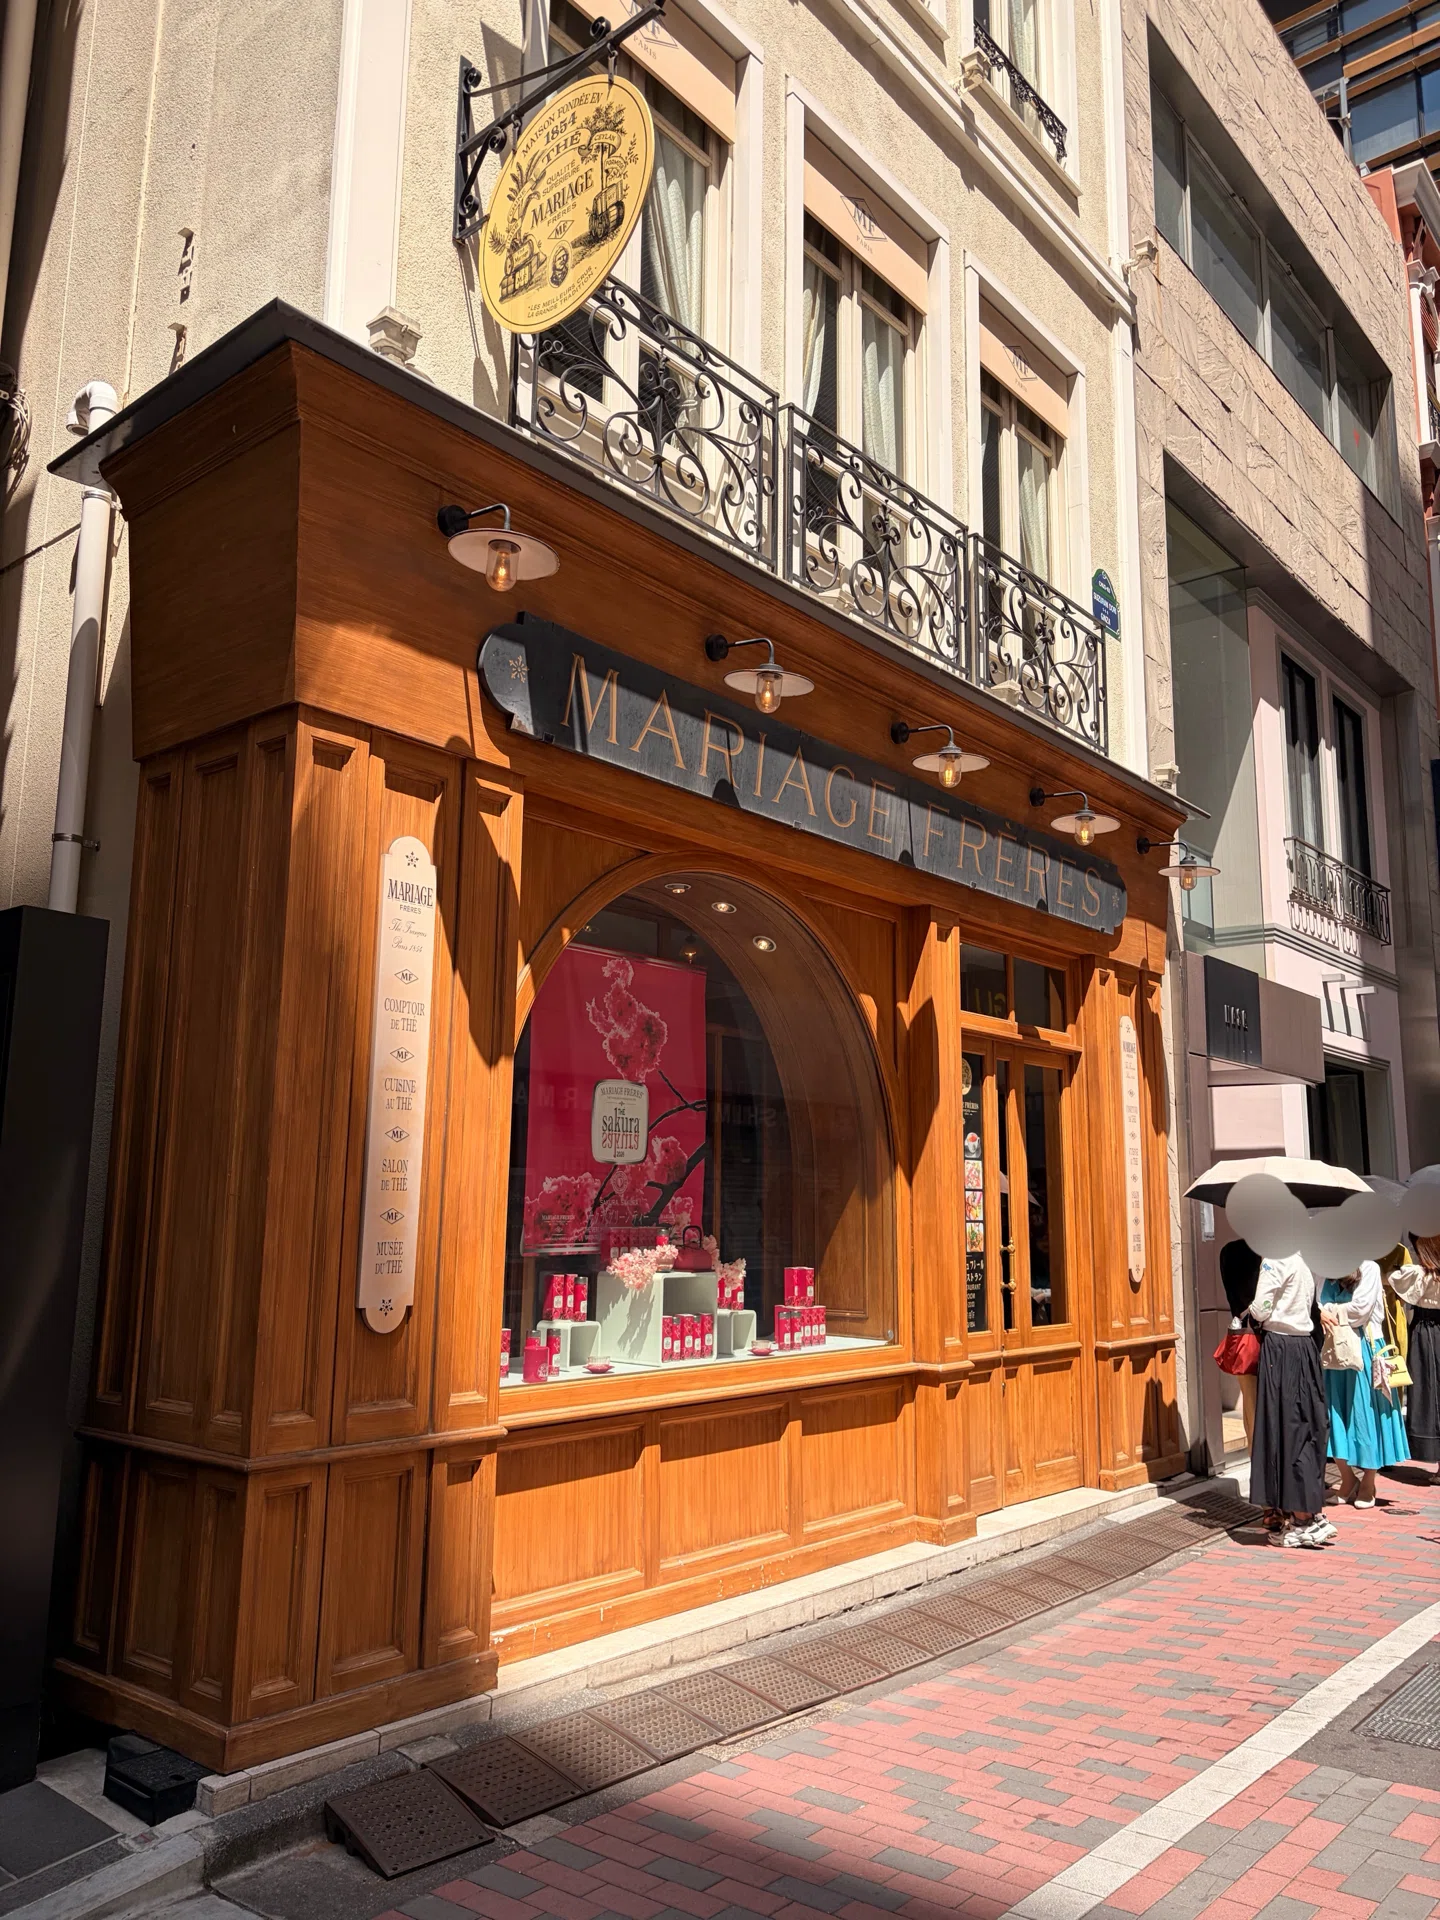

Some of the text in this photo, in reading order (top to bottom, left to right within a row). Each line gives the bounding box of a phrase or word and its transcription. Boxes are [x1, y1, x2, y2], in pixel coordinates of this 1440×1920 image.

[633, 34, 657, 60] PARIS
[522, 92, 604, 158] MAISON FONDÉE EN
[544, 110, 577, 147] 1854
[541, 130, 582, 166] THÉ
[546, 159, 576, 185] QUALITÉ
[530, 168, 594, 229] MARIAGE
[852, 200, 876, 237] MF
[530, 265, 592, 311] LES MEILLEURS CRUS
[535, 303, 558, 317] GRANDE
[560, 270, 594, 305] TRADITION
[560, 652, 1101, 917] MARIAGE FRÈRES
[387, 878, 433, 907] MARIAGE
[400, 972, 413, 981] MF
[384, 997, 425, 1017] COMPTOIR
[390, 1016, 418, 1032] DE THÉ
[396, 1050, 409, 1059] MF
[384, 1077, 416, 1093] CUISINE
[600, 1086, 623, 1096] MARIAGE
[385, 1093, 413, 1111] AU THÉ
[602, 1107, 640, 1133] sakura
[381, 1158, 409, 1174] SALON
[381, 1173, 408, 1191] DE THÉ
[376, 1237, 403, 1256] MUSÉE
[374, 1256, 403, 1275] DU THÉ
